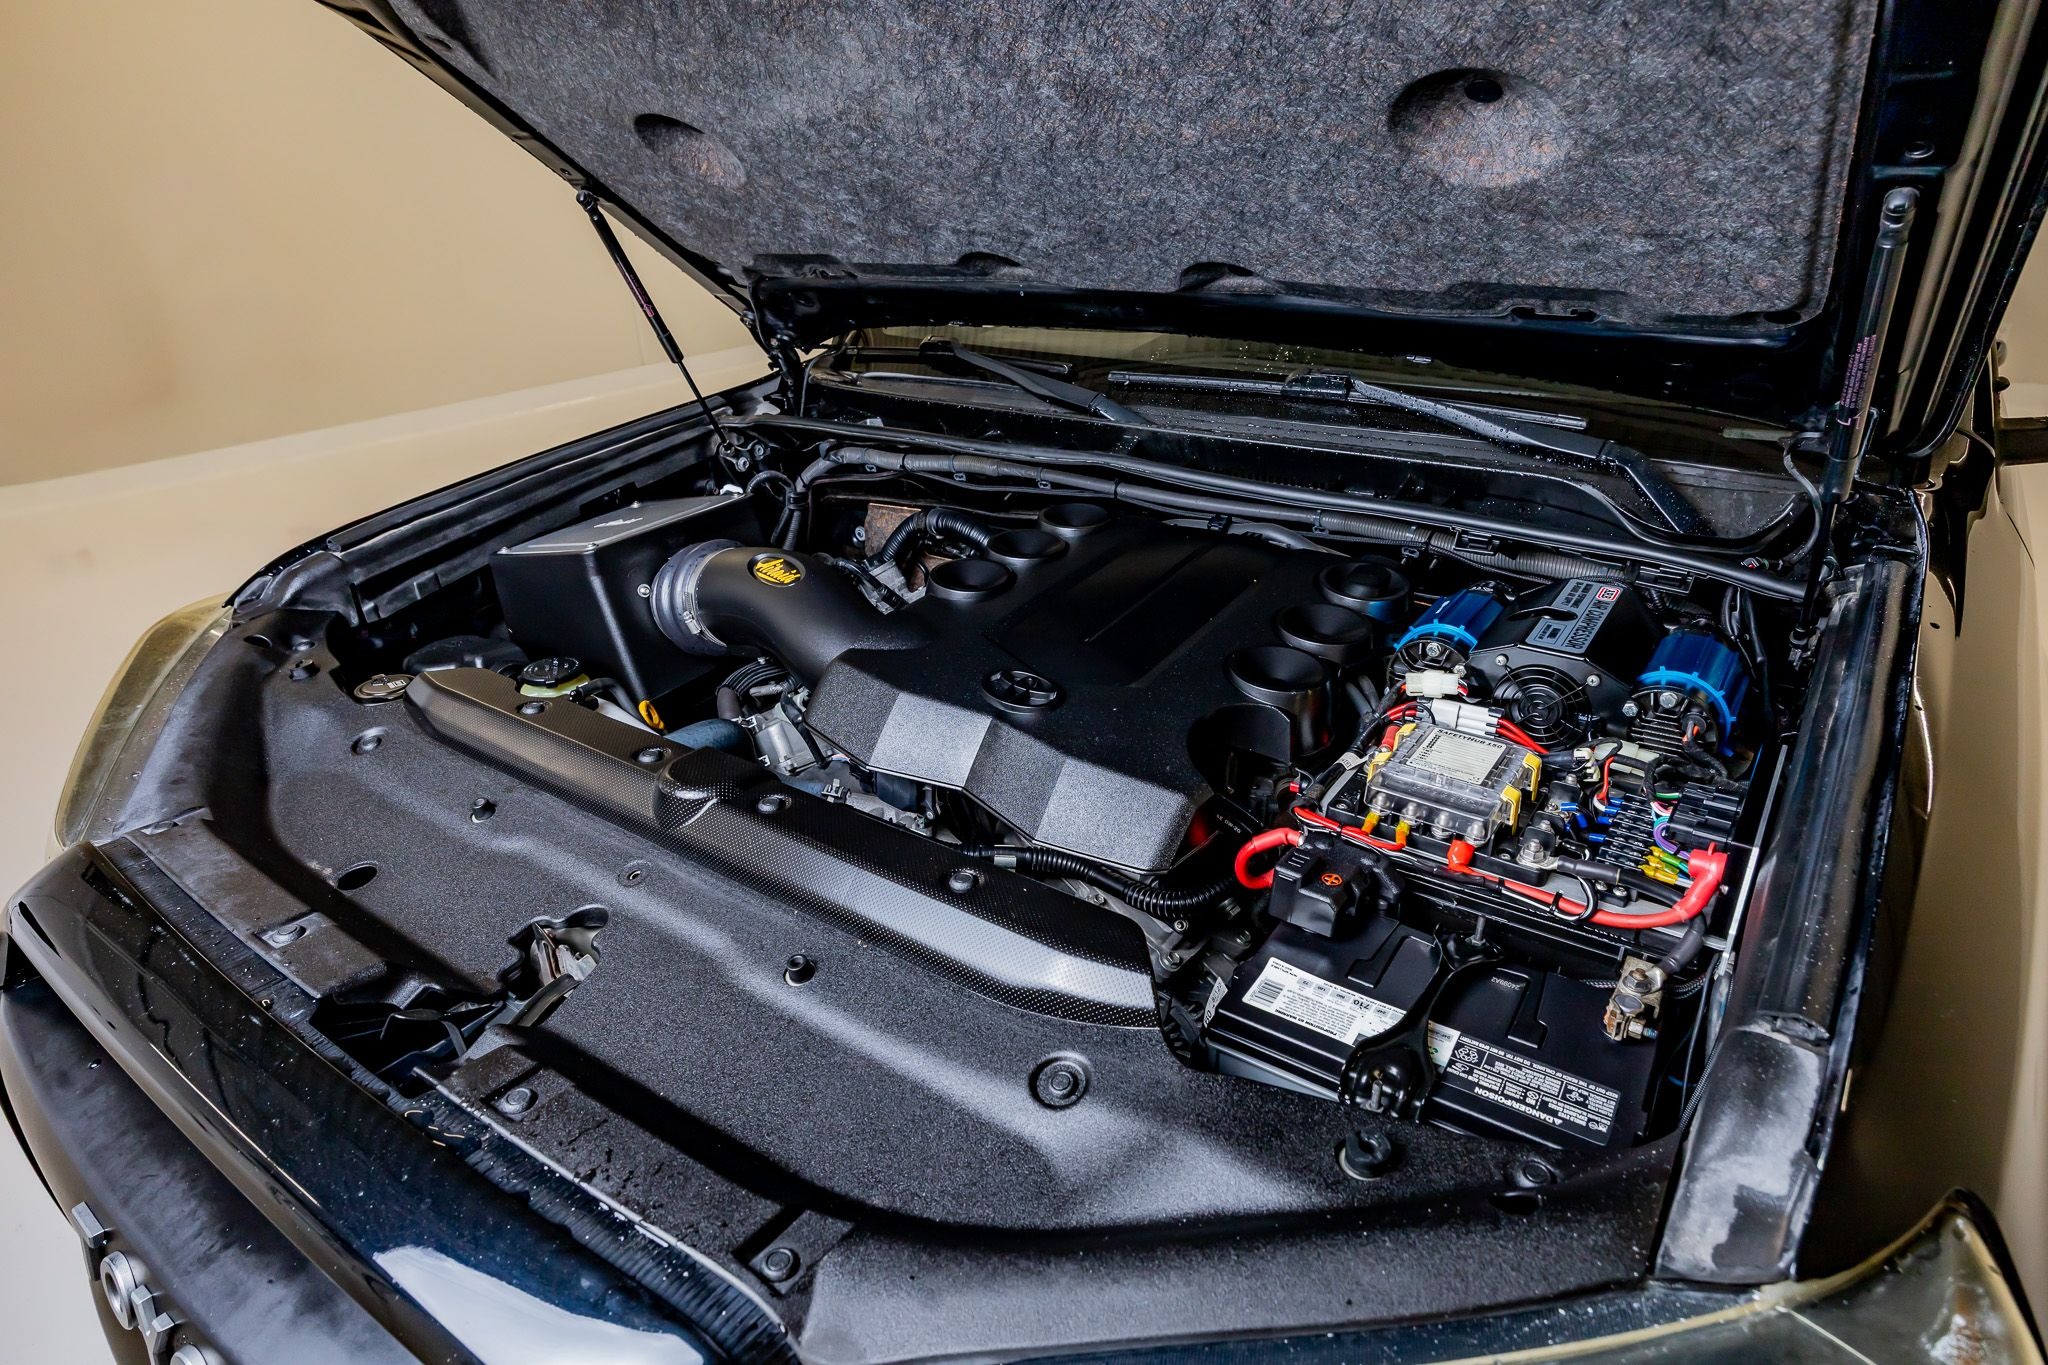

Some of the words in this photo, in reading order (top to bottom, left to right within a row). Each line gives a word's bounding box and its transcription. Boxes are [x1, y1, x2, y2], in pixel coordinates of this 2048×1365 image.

[1592, 600, 1611, 610] AIR
[1566, 610, 1604, 649] COMPRESSOR
[1351, 998, 1371, 1009] 710
[1273, 1008, 1297, 1019] WARNING
[1303, 1020, 1338, 1035] PROPOSITION
[1473, 1086, 1553, 1122] DANGER/POISON
